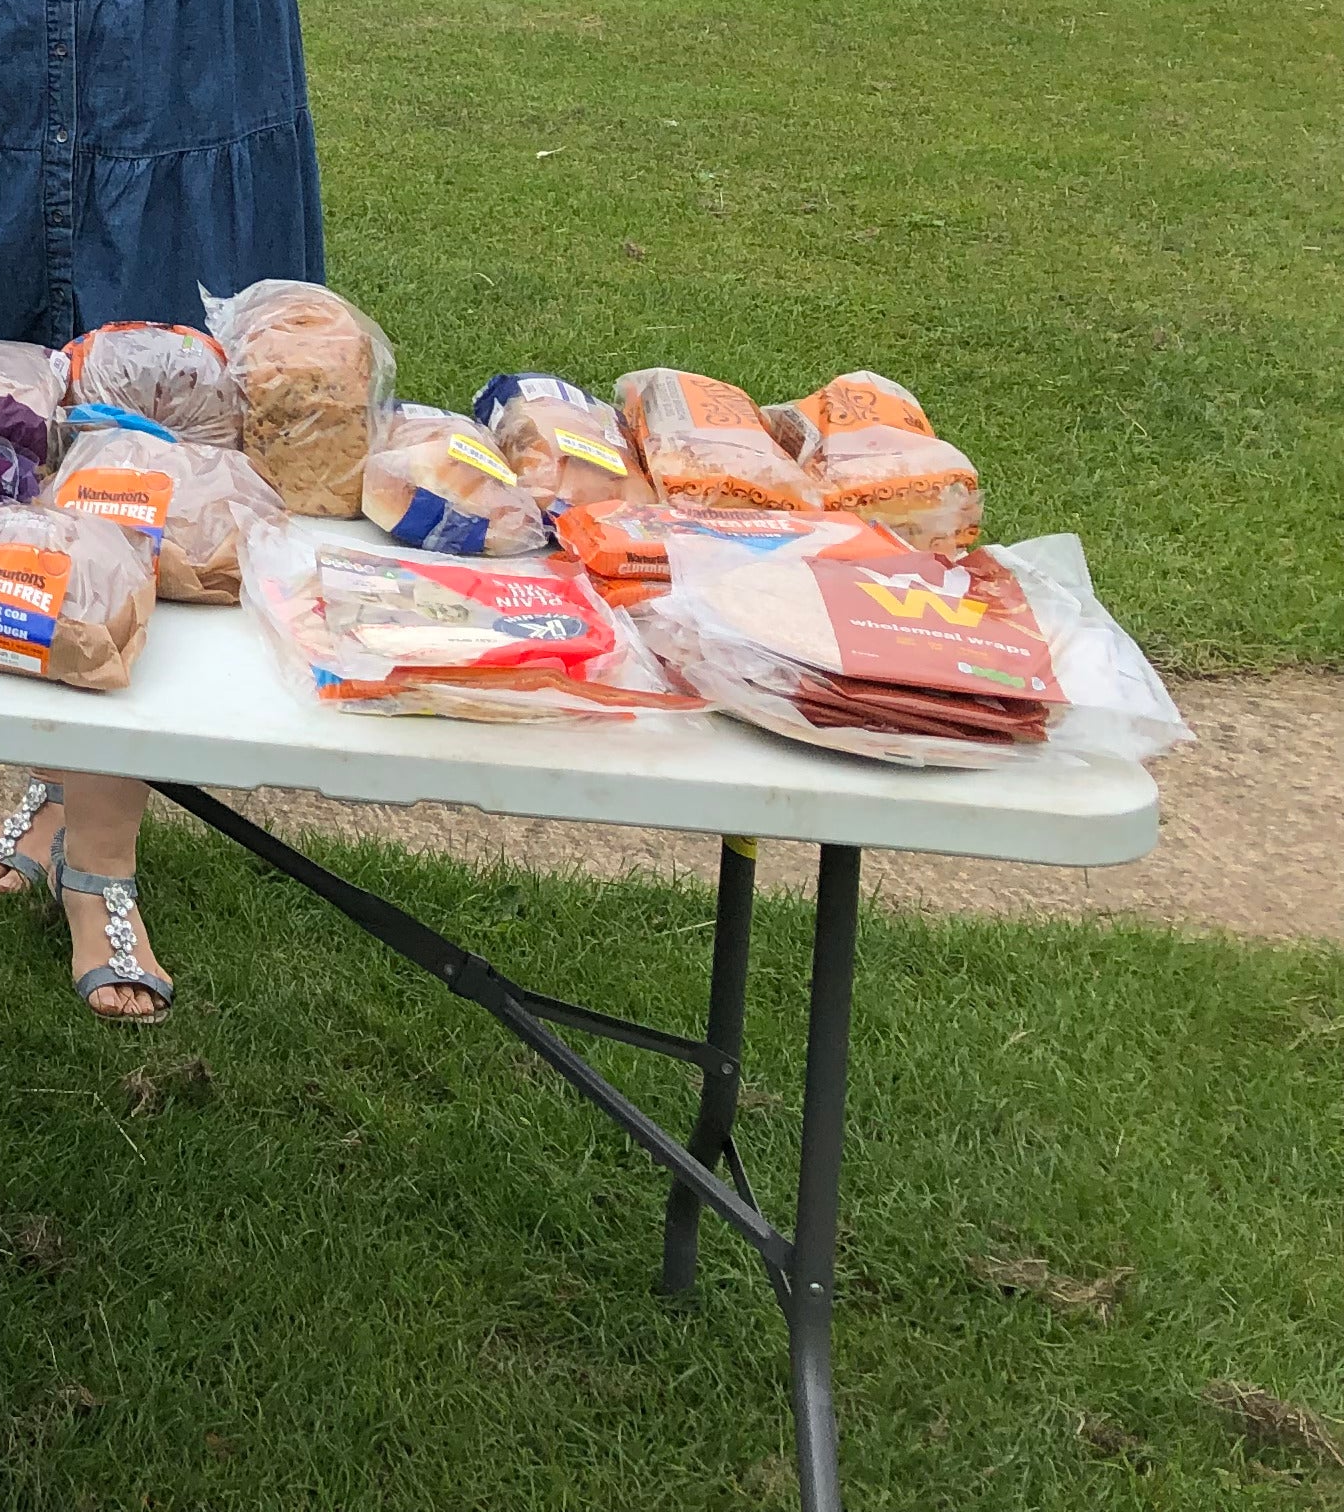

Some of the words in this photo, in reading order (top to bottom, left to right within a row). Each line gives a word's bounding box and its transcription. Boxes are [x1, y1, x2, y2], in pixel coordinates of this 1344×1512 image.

[77, 485, 150, 504] Warburtons
[119, 505, 157, 524] FREE
[745, 519, 797, 531] FREE
[13, 584, 53, 613] FREE
[495, 595, 562, 608] PLAIN
[4, 607, 28, 622] COB
[849, 618, 962, 643] wholemeal
[967, 636, 1032, 657] wraps
